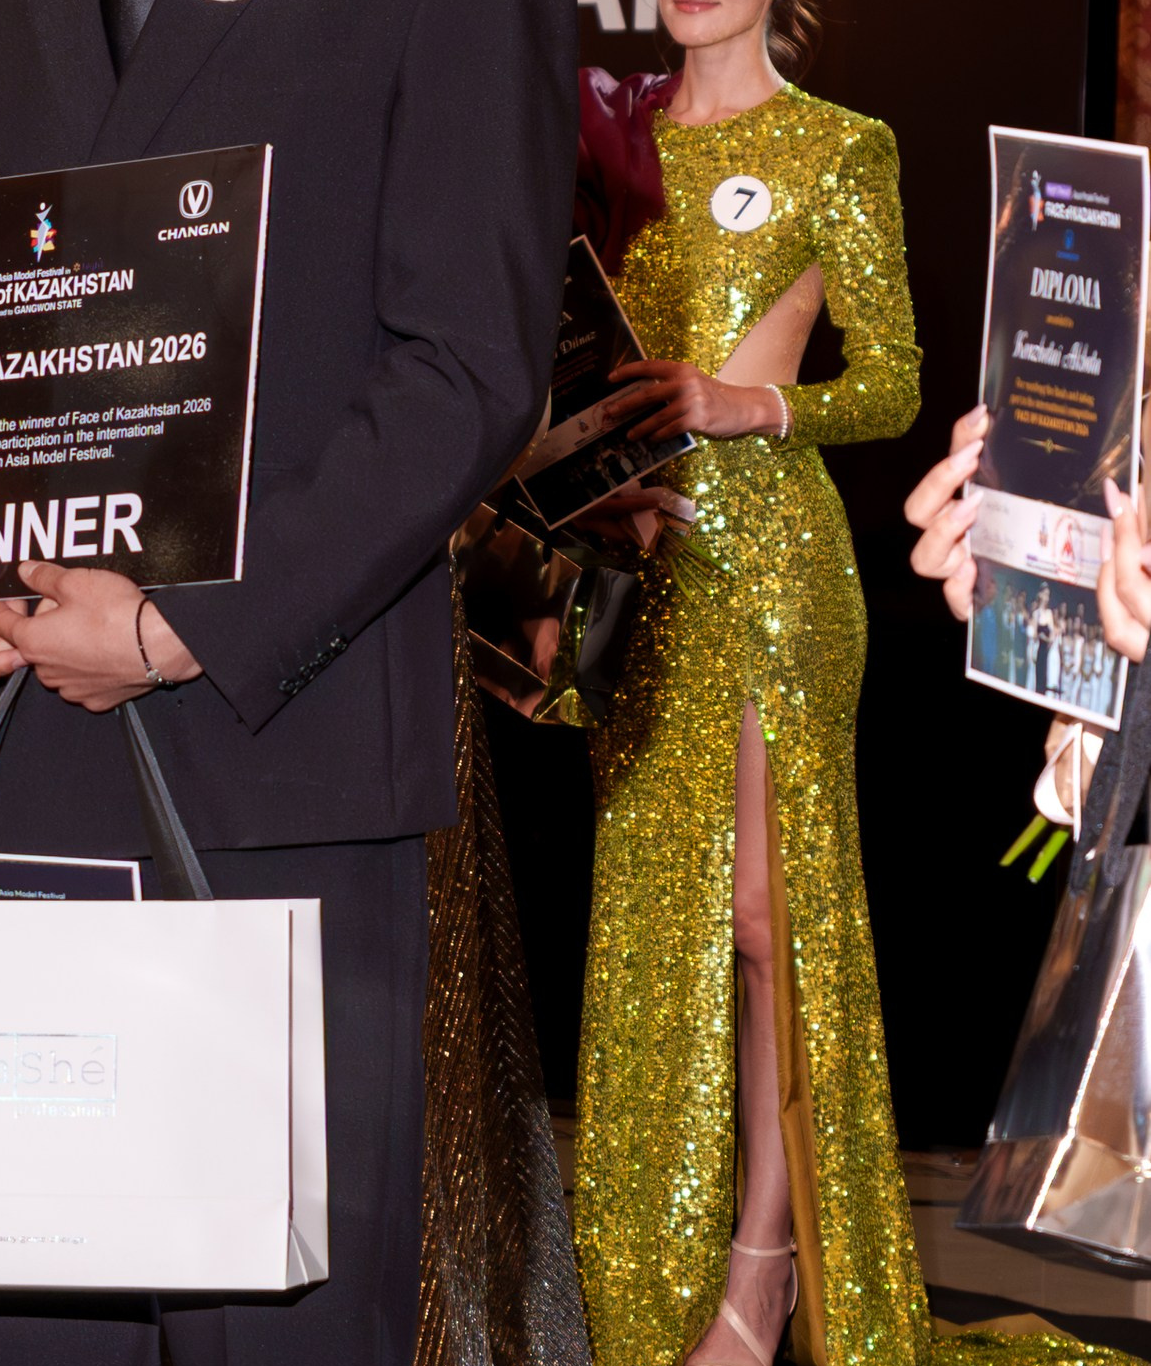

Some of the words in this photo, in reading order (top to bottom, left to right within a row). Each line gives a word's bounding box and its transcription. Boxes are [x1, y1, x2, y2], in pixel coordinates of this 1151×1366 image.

[733, 187, 758, 220] 7
[157, 221, 230, 241] CHANGAN
[13, 269, 134, 303] KAZAKHSTAN
[14, 269, 36, 281] Model
[36, 266, 64, 279] Festival
[1030, 267, 1101, 310] DIPLOMA
[14, 301, 57, 315] GANGWON
[57, 298, 83, 311] STATE
[148, 331, 207, 365] 2026
[0, 418, 16, 432] the
[18, 415, 58, 431] winner
[58, 412, 71, 427] of
[72, 411, 99, 425] Face
[102, 407, 115, 422] of
[115, 402, 181, 421] Kazakhstan
[182, 397, 212, 414] 2026
[63, 430, 74, 444] in
[76, 429, 94, 443] the
[96, 421, 165, 441] international
[5, 453, 30, 468] Asia
[32, 448, 67, 466] Model
[69, 443, 115, 462] Festival.
[14, 890, 37, 898] Model
[38, 891, 66, 900] Festival
